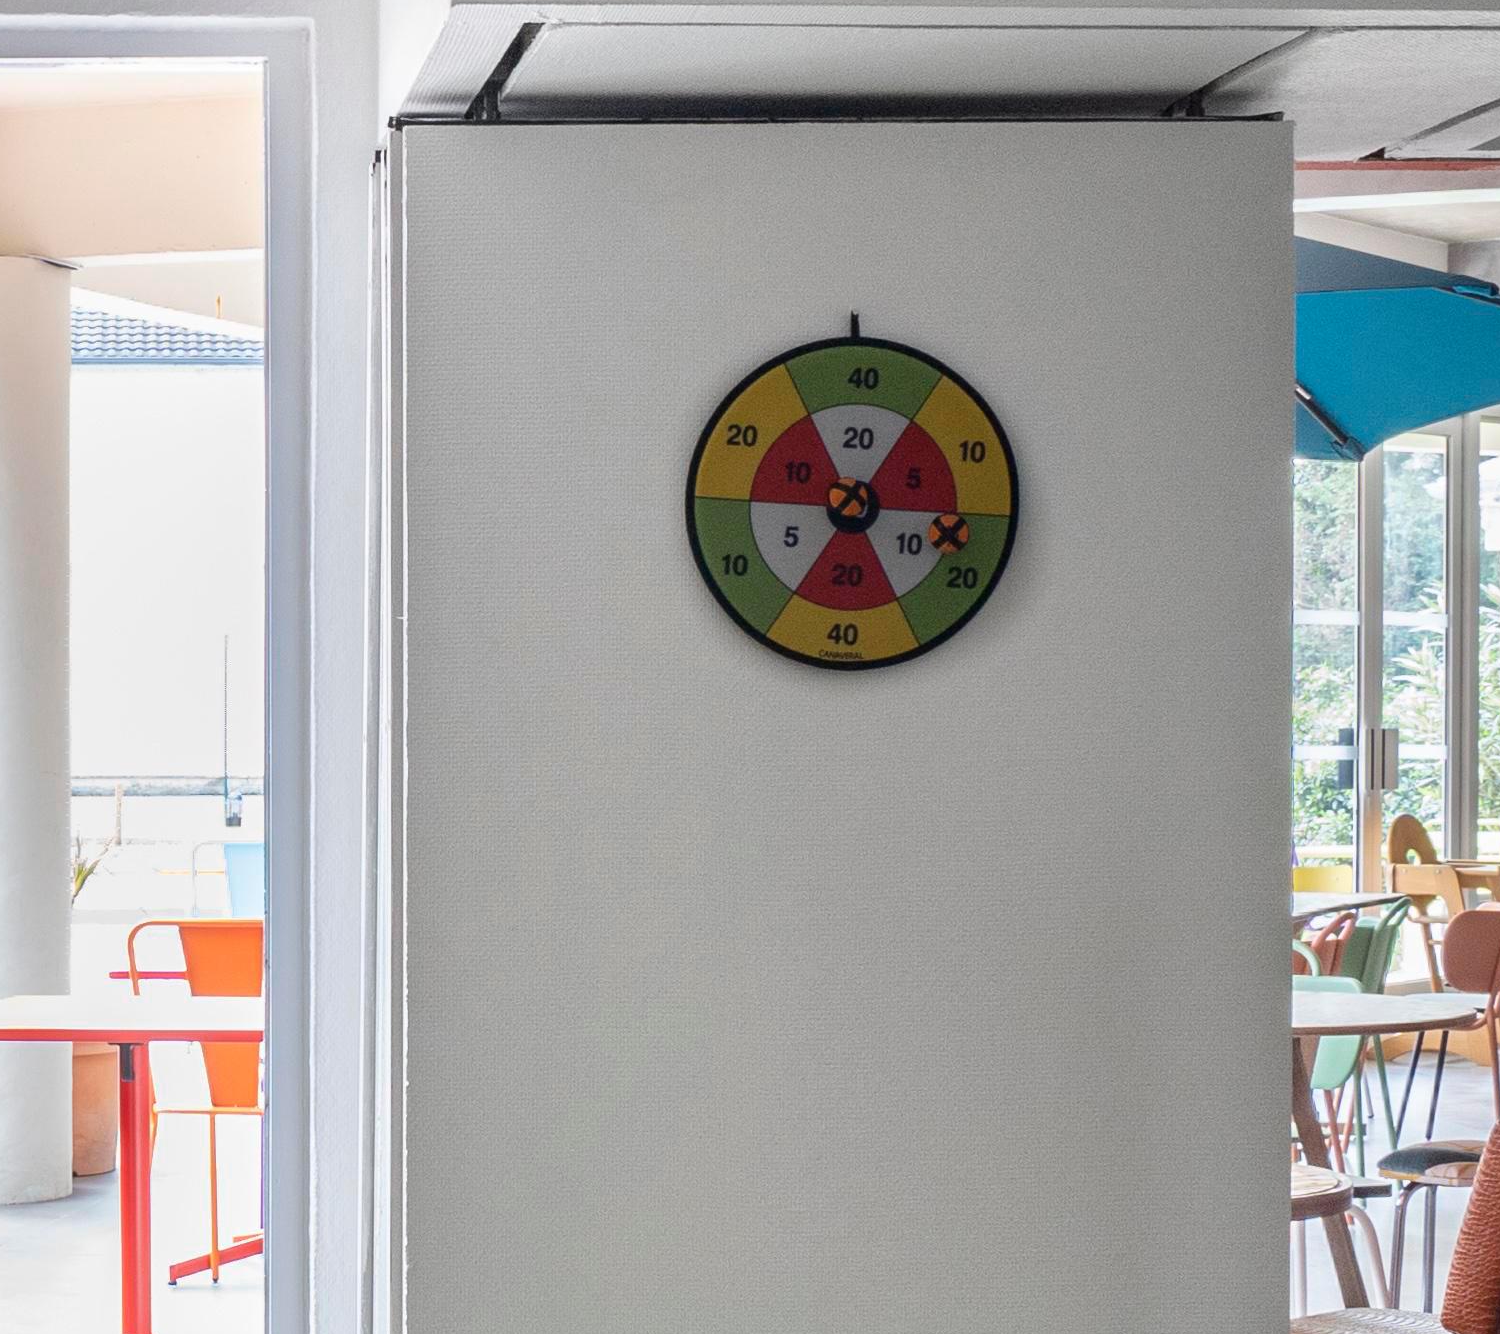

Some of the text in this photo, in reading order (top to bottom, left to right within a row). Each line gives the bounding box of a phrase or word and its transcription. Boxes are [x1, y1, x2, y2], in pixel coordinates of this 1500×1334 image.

[848, 367, 879, 391] 40
[726, 424, 758, 447] 20
[842, 427, 874, 450] 20
[959, 440, 986, 463] 10
[785, 461, 812, 484] 10
[905, 467, 921, 490] 5
[783, 525, 799, 548] 5
[896, 533, 922, 555] 10
[722, 554, 748, 577] 10
[831, 563, 862, 586] 20
[946, 567, 978, 590] 20
[827, 623, 858, 646] 40
